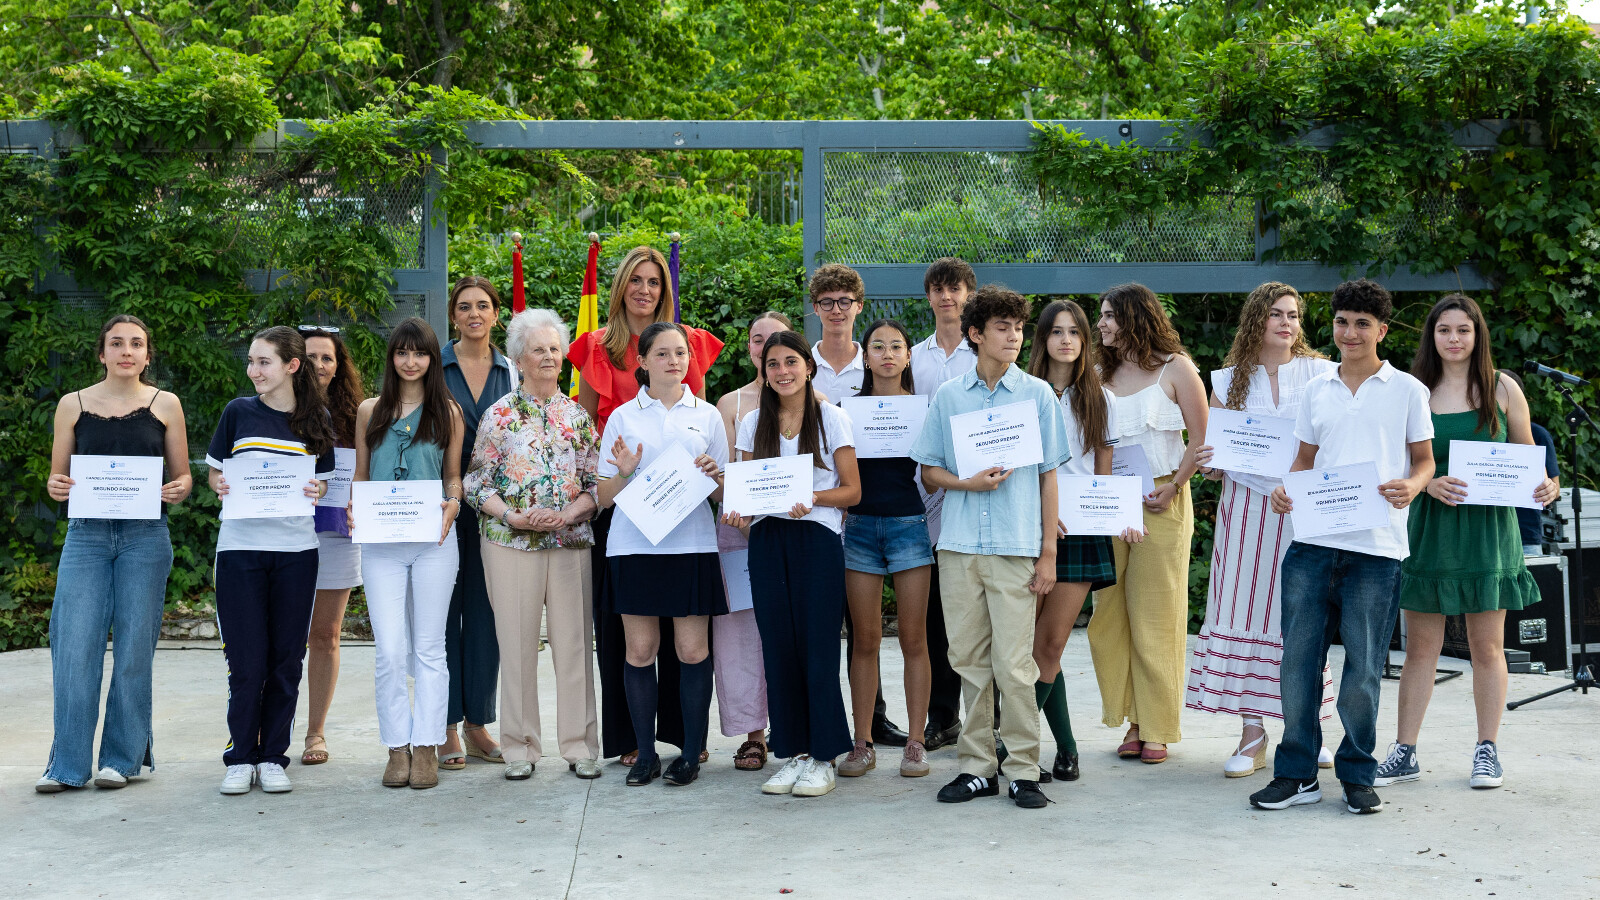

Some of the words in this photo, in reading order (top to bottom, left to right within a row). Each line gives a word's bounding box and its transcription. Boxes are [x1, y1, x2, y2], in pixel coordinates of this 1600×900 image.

[976, 439, 999, 447] SEGUNDO
[652, 492, 668, 508] PRIMER
[667, 479, 683, 494] PREMIO
